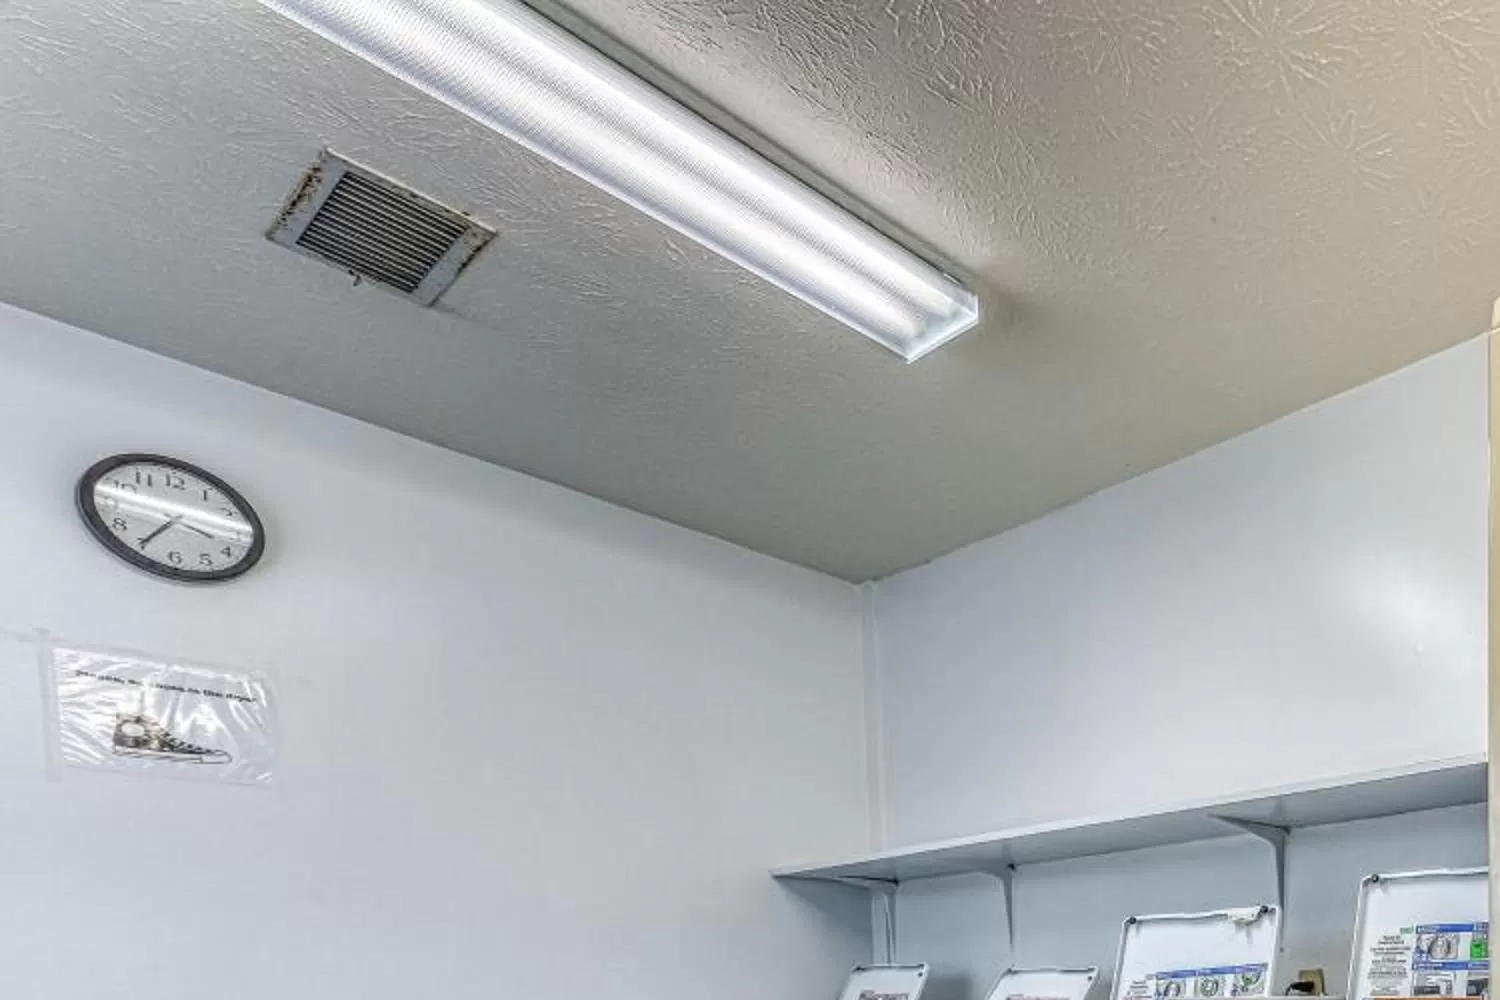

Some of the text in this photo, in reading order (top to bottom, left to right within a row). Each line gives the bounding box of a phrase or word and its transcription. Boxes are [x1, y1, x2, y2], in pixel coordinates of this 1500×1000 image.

[136, 470, 153, 487] 11
[166, 473, 186, 490] 12
[167, 551, 183, 565] 6
[199, 553, 213, 567] 5
